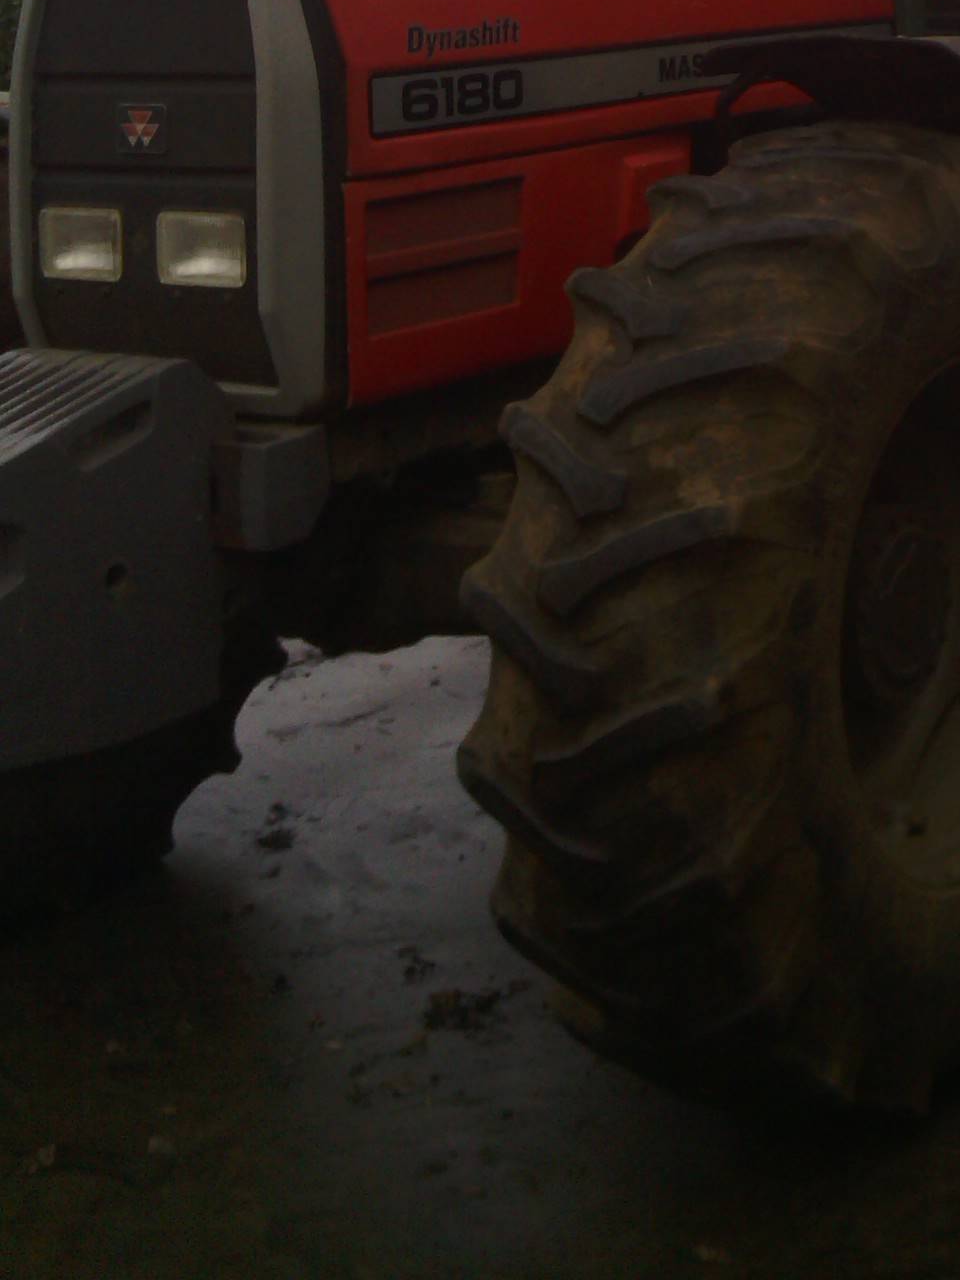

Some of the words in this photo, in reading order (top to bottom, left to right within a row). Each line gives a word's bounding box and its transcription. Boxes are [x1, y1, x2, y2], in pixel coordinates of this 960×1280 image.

[407, 19, 519, 57] Dynashift
[658, 53, 704, 82] MAS
[402, 70, 523, 122] 6180
